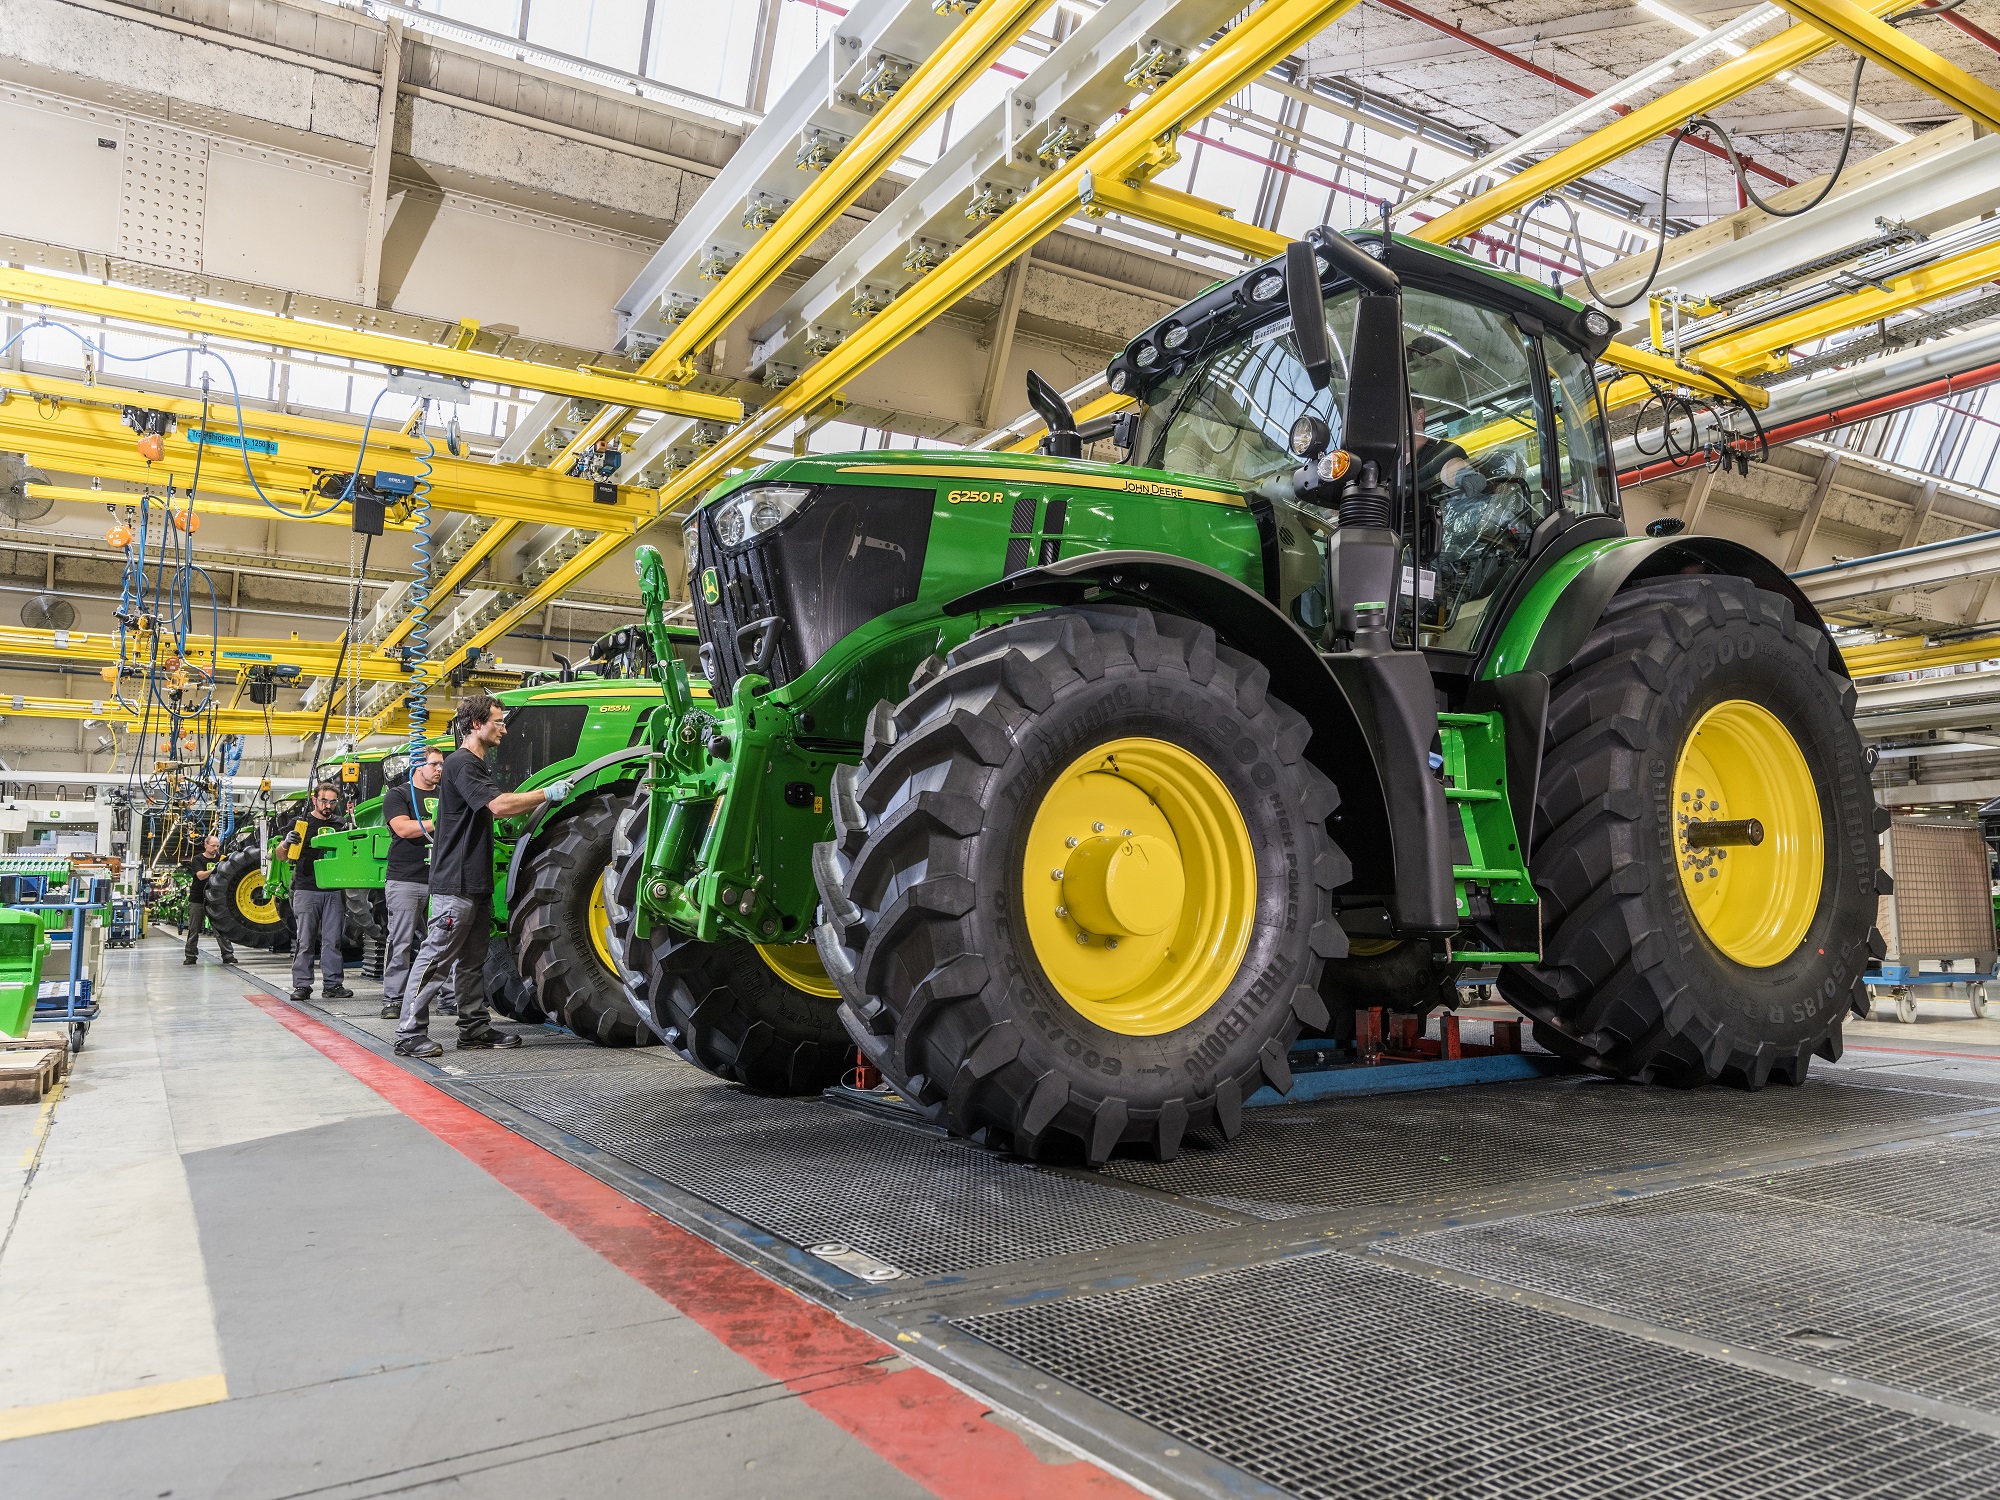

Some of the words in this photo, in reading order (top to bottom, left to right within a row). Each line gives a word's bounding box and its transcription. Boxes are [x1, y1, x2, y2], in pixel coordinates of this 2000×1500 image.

[234, 437, 250, 446] mx.
[252, 439, 266, 448] 1250
[948, 490, 991, 504] 6250
[993, 492, 1004, 504] R
[1123, 481, 1150, 494] JOHN
[1151, 484, 1183, 497] DEERE
[1698, 632, 1757, 680] 900
[1209, 714, 1277, 790] 900
[1833, 716, 1871, 895] TRELLEBORG
[1269, 793, 1294, 848] HIGH
[1285, 853, 1299, 934] POWER
[1649, 758, 1693, 961] TRELLEBORG
[562, 910, 611, 999] TRELLEBORG
[1019, 987, 1122, 1076] 600/70
[1183, 953, 1298, 1083] TRELLEBORG
[1767, 1004, 1784, 1024] R
